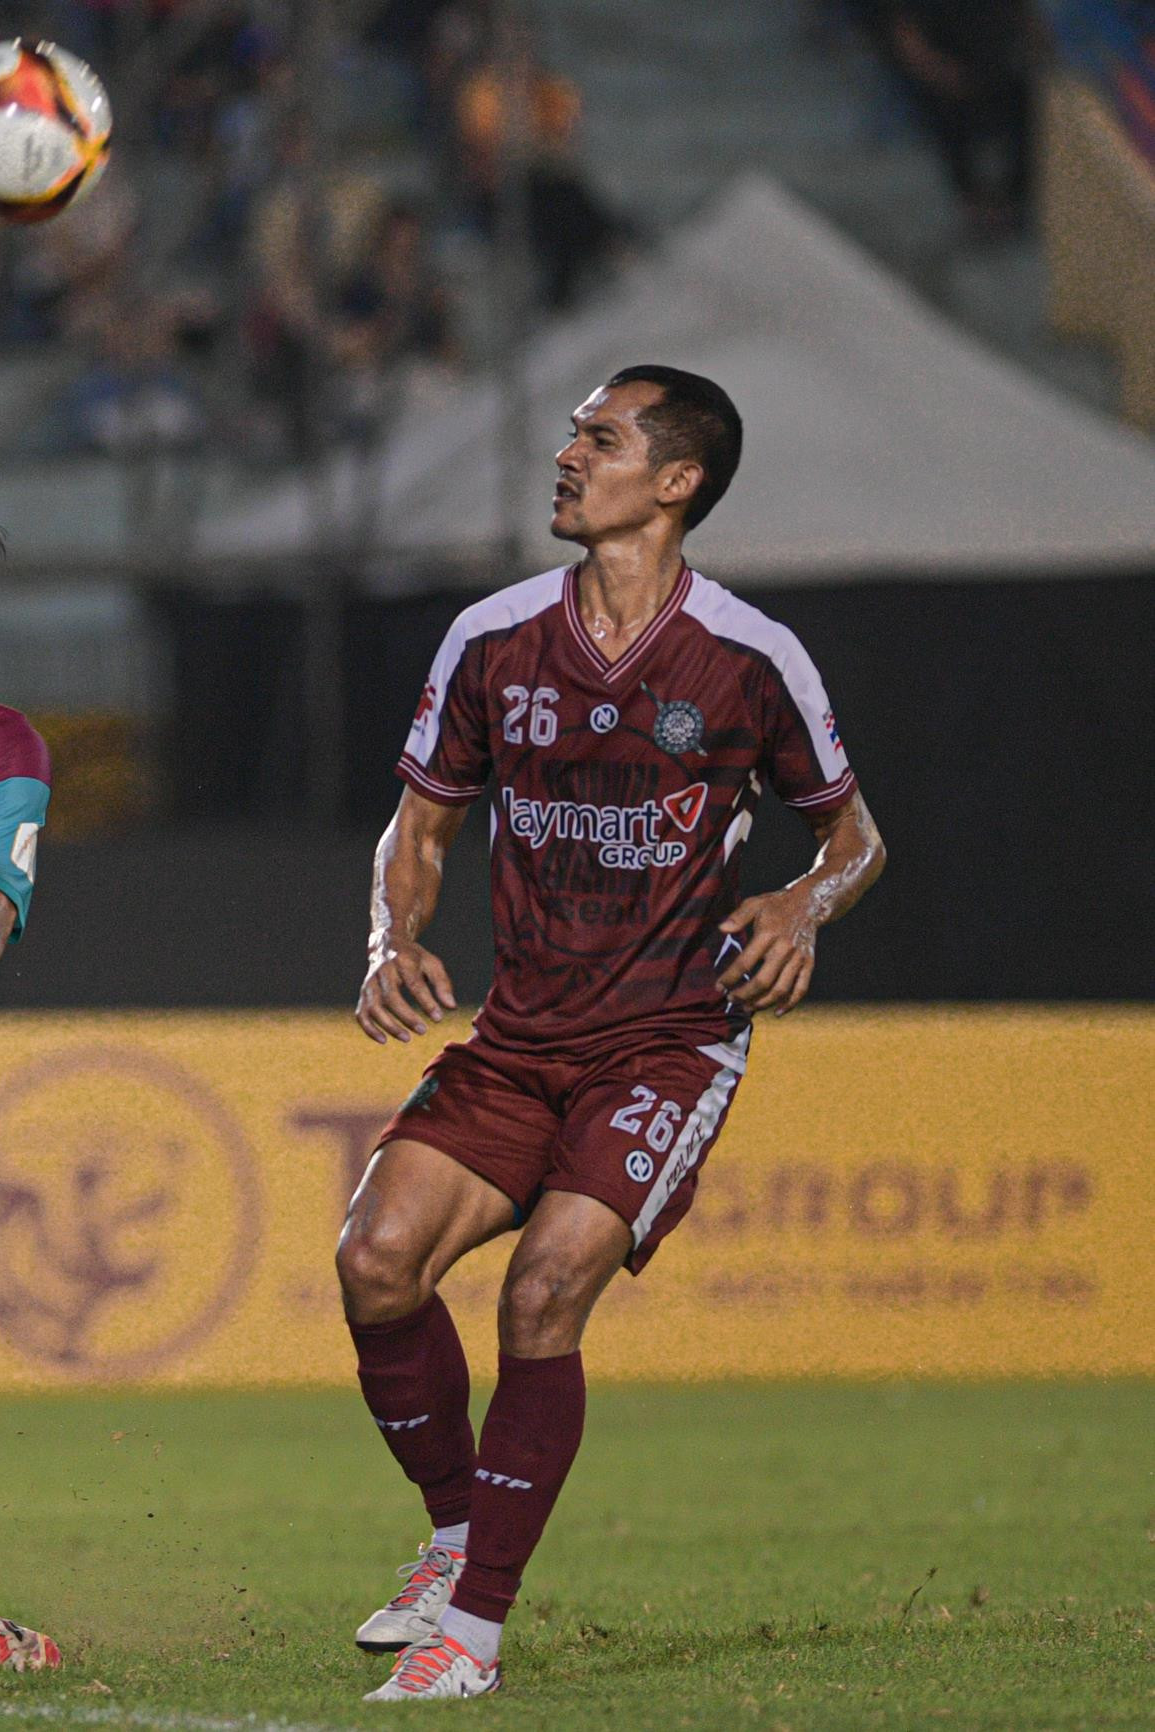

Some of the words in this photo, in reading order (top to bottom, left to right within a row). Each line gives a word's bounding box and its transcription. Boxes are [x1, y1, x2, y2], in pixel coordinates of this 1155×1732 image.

[502, 684, 560, 746] 26
[600, 842, 686, 869] GROUP
[609, 1084, 682, 1153] 26
[474, 1467, 533, 1490] RTP
